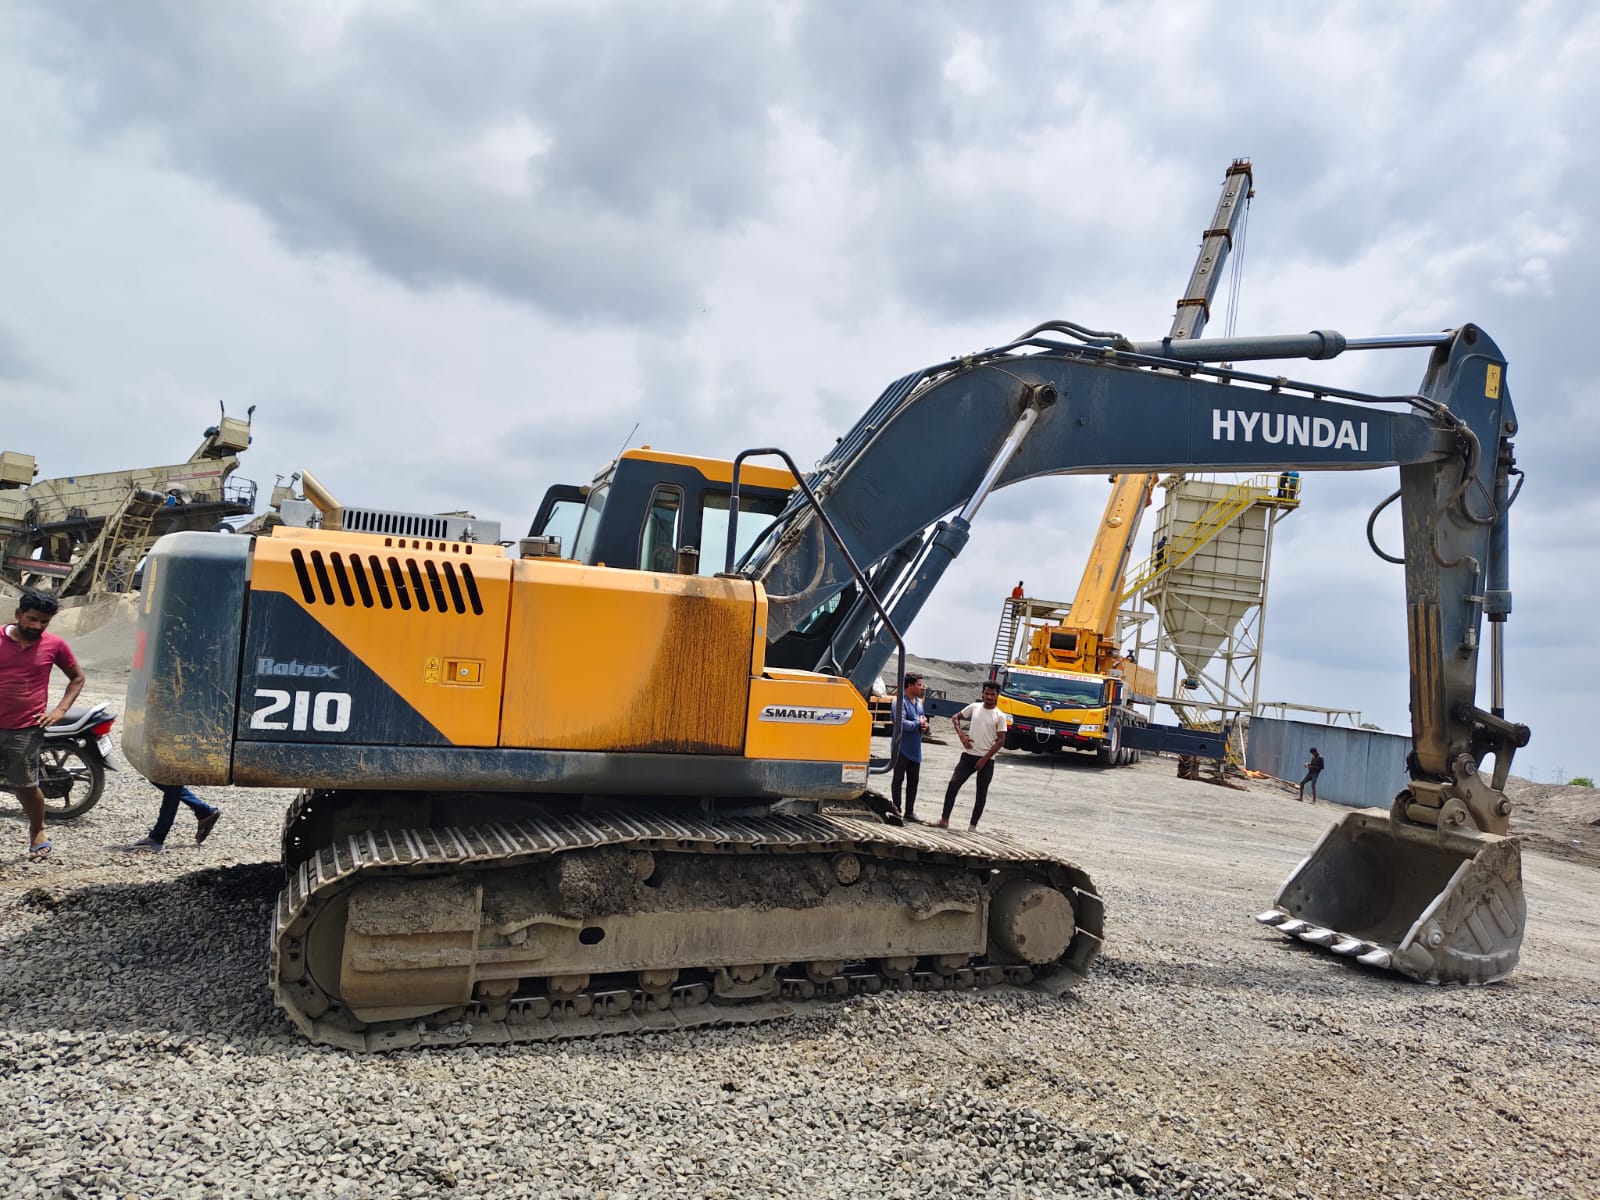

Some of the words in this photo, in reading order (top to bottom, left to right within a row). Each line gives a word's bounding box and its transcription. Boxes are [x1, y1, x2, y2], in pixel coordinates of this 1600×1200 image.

[1212, 408, 1368, 452] HYUNDAI
[257, 657, 342, 680] Robex
[250, 689, 352, 733] 210
[764, 708, 817, 720] SMART
[817, 710, 848, 721] plus
